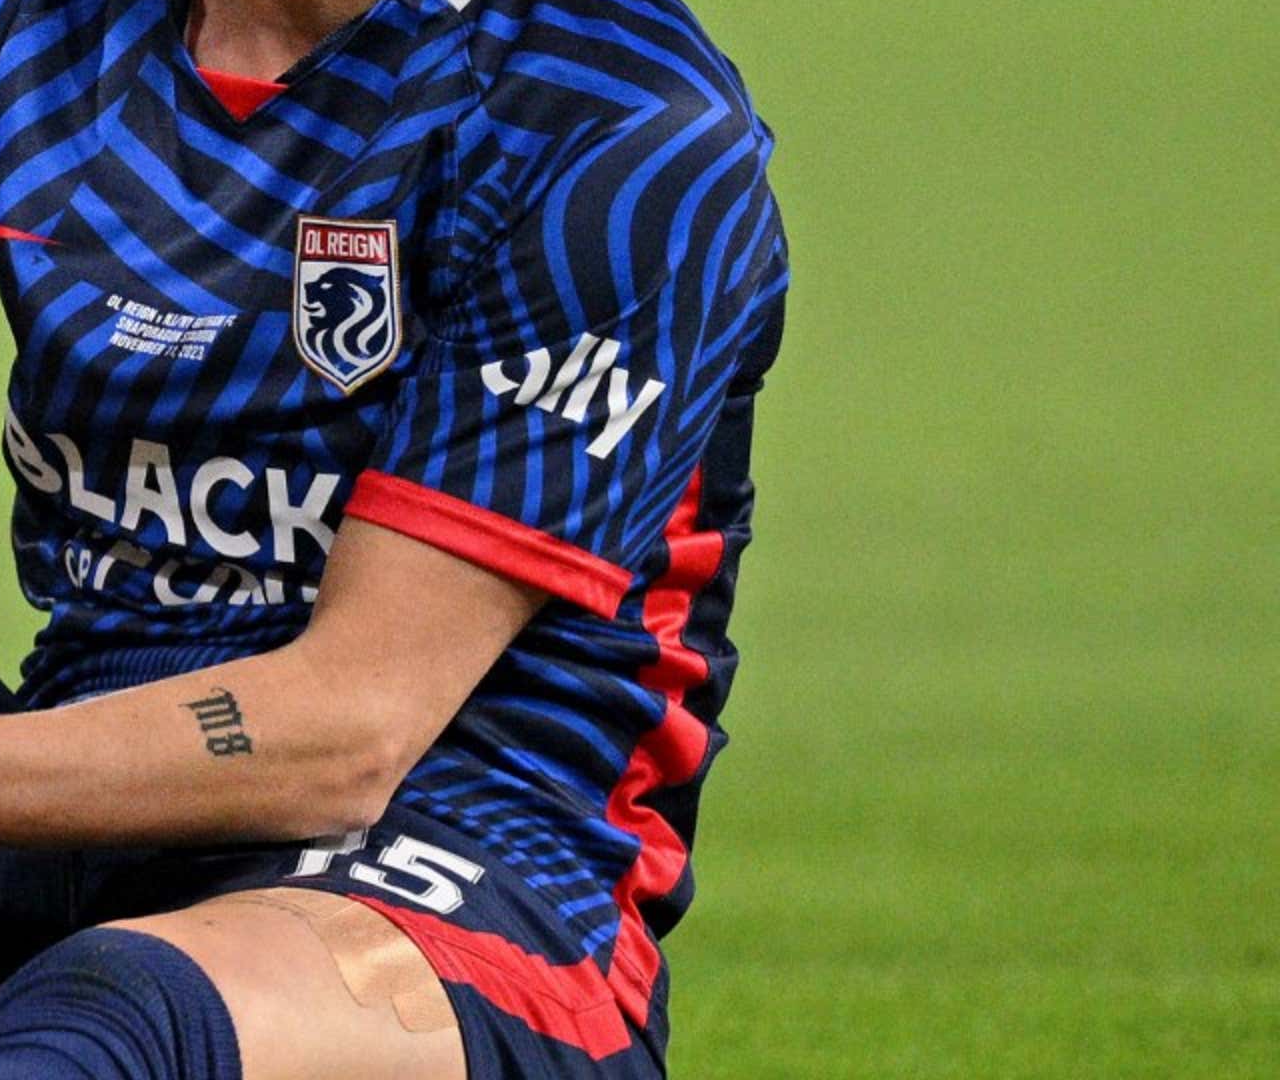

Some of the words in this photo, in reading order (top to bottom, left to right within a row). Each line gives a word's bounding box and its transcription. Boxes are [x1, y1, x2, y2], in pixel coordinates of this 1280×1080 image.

[305, 229, 325, 255] OL
[327, 231, 385, 259] REIGN
[480, 332, 666, 460] ally
[5, 407, 341, 563] BLACK
